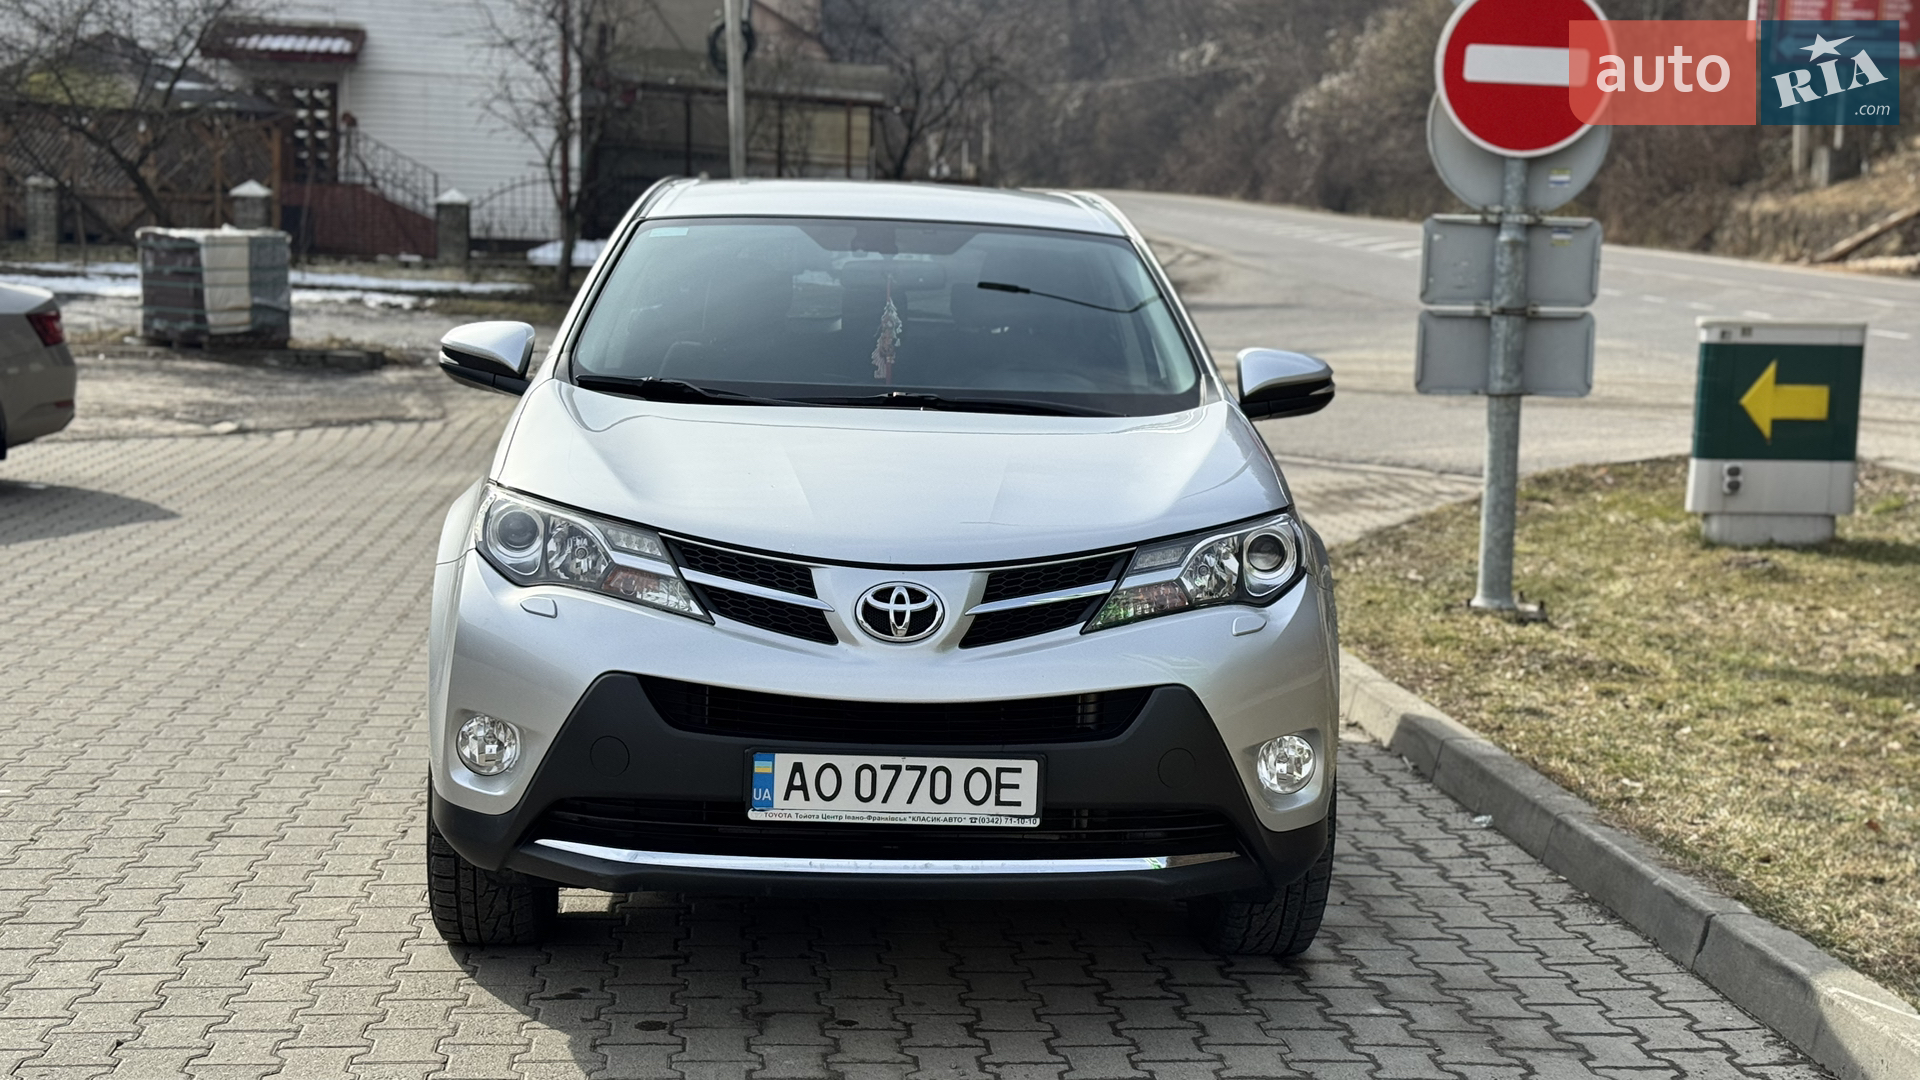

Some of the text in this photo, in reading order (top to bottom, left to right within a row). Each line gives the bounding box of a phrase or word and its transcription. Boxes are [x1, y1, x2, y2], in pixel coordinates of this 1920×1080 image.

[753, 788, 772, 802] UA
[783, 761, 1022, 807] AO 0770 OE
